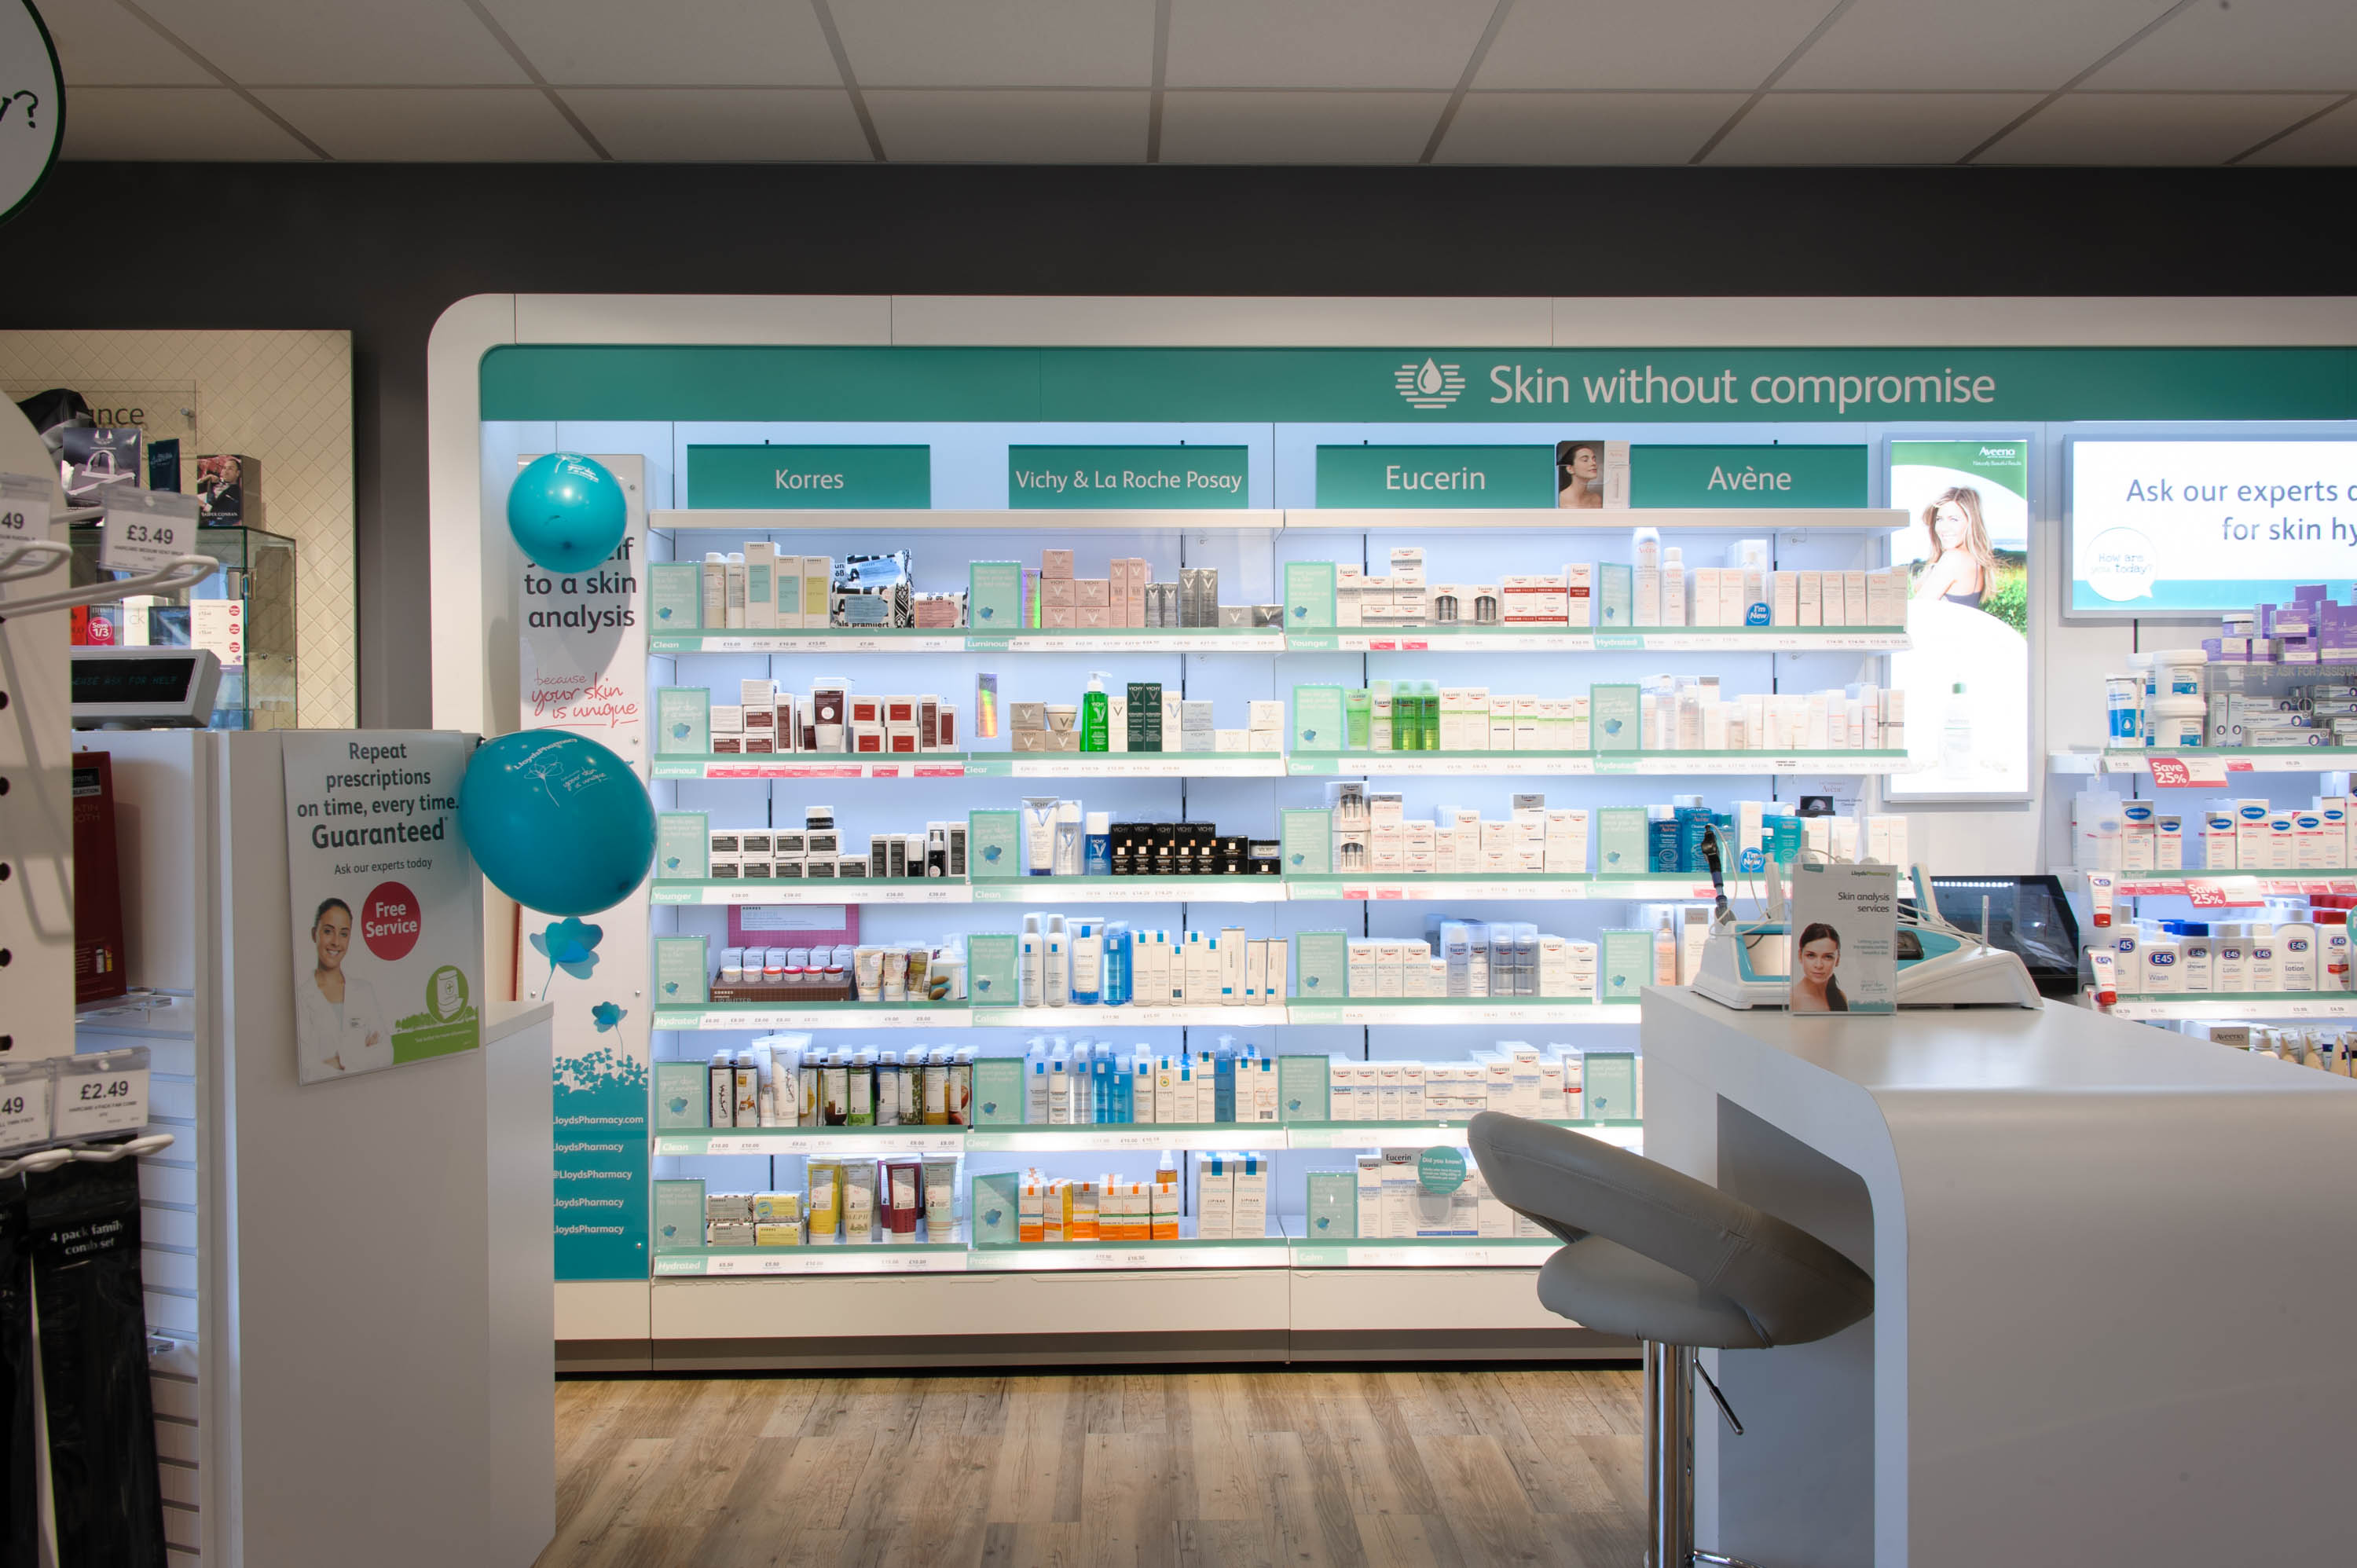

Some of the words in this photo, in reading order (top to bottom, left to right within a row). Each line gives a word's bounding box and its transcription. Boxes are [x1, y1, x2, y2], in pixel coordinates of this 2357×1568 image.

[1490, 365, 1570, 405] Skin
[1583, 365, 1737, 405] without
[1749, 366, 1996, 414] compromise
[1979, 445, 2016, 456] Aveeno
[775, 469, 845, 490] Korres
[1016, 470, 1068, 493] Vichy
[1073, 471, 1089, 489] &
[1095, 470, 1117, 489] La
[1122, 470, 1182, 489] Roche
[1186, 471, 1243, 493] Posay
[1386, 466, 1486, 492] Eucerin
[1707, 464, 1792, 492] Avène
[2126, 478, 2174, 503] Ask
[2183, 484, 2229, 503] our
[2237, 481, 2339, 508] experts
[2223, 516, 2260, 541] for
[2269, 516, 2322, 541] skin
[127, 525, 174, 544] £3.49
[2099, 552, 2121, 563] How
[2115, 562, 2153, 574] today?
[524, 573, 552, 595] to
[561, 577, 577, 595] a
[586, 570, 637, 595] skin
[1753, 604, 1766, 613] I'm
[129, 608, 145, 625] ck
[528, 604, 635, 634] analysis
[93, 628, 109, 637] 1/3
[967, 640, 1009, 649] Luminous
[1290, 639, 1329, 649] Younger
[535, 668, 587, 686] because
[2277, 667, 2294, 676] ASK
[2298, 667, 2315, 676] FOR
[532, 687, 580, 716] your
[585, 672, 624, 701] skin
[552, 704, 567, 720] is
[573, 699, 639, 728] unique
[349, 742, 407, 764] Repeat
[654, 766, 697, 775] Luminous
[964, 765, 988, 774] Clear
[2153, 762, 2184, 773] Save
[326, 769, 431, 793] prescriptions
[2156, 772, 2187, 785] 25%
[297, 804, 318, 818] on
[324, 798, 368, 818] time,
[372, 798, 415, 816] every
[420, 794, 460, 811] time.
[334, 865, 351, 875] Ask
[354, 863, 369, 874] our
[372, 859, 405, 874] experts
[407, 857, 433, 870] today
[2187, 883, 2218, 894] Save
[654, 892, 692, 902] Younger
[975, 891, 1001, 899] Clean
[1838, 892, 1856, 901] Skin
[1857, 892, 1890, 903] analysis
[2192, 893, 2223, 904] 25%
[376, 903, 406, 918] Free
[1857, 904, 1890, 913] services
[365, 918, 418, 938] Service
[2120, 940, 2133, 950] 45
[2290, 941, 2307, 951] E45
[2154, 954, 2172, 963] E45
[2224, 950, 2238, 958] E45
[2256, 950, 2271, 958] E45
[2148, 973, 2169, 981] Wash
[656, 1017, 698, 1027] Hydrated
[2215, 1032, 2245, 1042] Aveeno
[81, 1081, 129, 1100] £2.49
[662, 1143, 689, 1152] Clean
[1385, 1153, 1412, 1162] Eucerin
[50, 1233, 57, 1242] 4
[61, 1229, 88, 1244] pack
[91, 1219, 123, 1236] family
[101, 1236, 115, 1248] set
[1299, 1253, 1323, 1262] Calm
[658, 1261, 701, 1271] Hydrated
